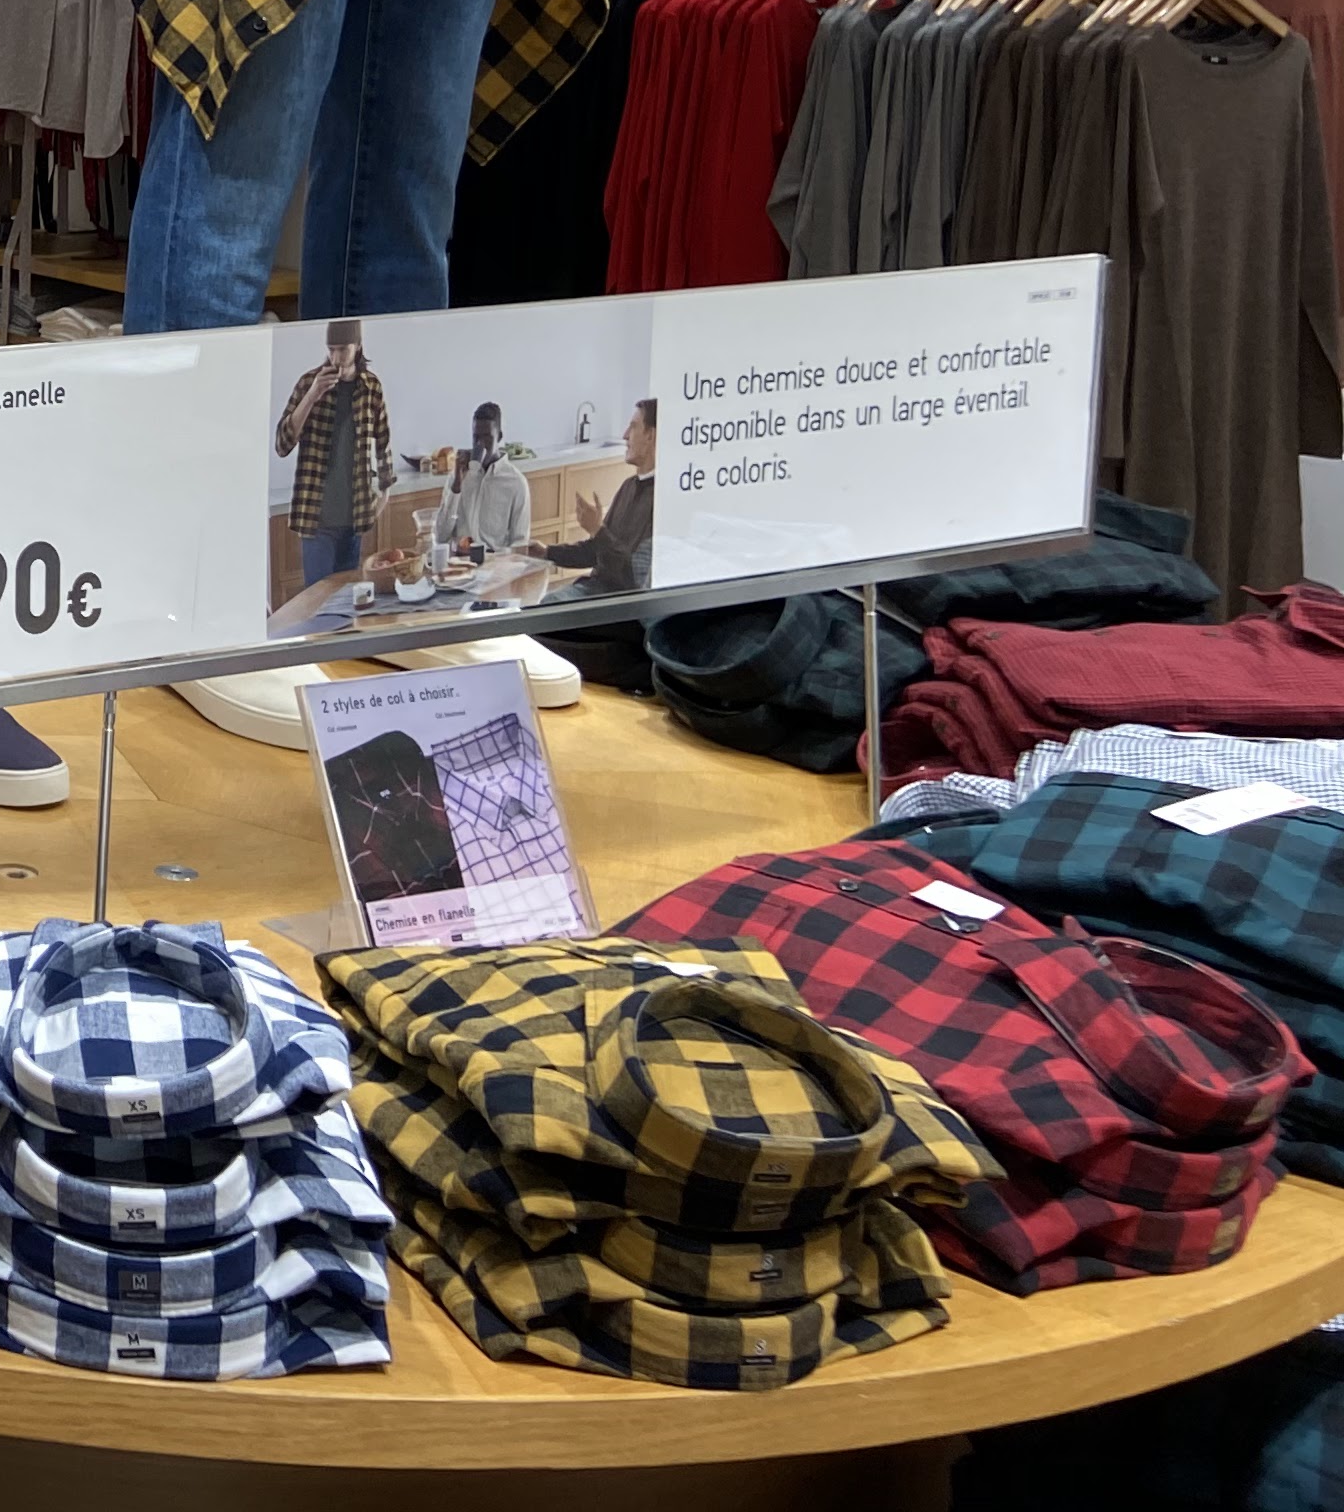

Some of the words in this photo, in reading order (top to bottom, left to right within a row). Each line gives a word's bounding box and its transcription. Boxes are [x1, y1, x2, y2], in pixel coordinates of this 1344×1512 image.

[683, 372, 725, 401] Une
[737, 362, 825, 395] chemise
[836, 357, 898, 385] douce
[908, 349, 928, 377] et
[937, 337, 1052, 374] confortable
[680, 409, 786, 451] disponible
[797, 404, 845, 434] dans
[856, 402, 881, 426] un
[892, 394, 945, 426] large
[954, 381, 1029, 415] éventail
[679, 463, 705, 491] de
[716, 452, 792, 487] coloris.
[321, 700, 329, 713] 2
[333, 695, 365, 715] styles
[370, 693, 383, 708] de
[387, 691, 405, 706] col
[408, 689, 416, 703] à
[375, 913, 417, 932] Chemise
[422, 913, 435, 925] en
[438, 905, 476, 921] flanelle
[128, 1099, 148, 1112] XS
[125, 1208, 145, 1220] XS
[761, 1253, 774, 1270] S
[132, 1274, 148, 1290] M
[127, 1333, 140, 1346] M
[755, 1339, 767, 1355] S
